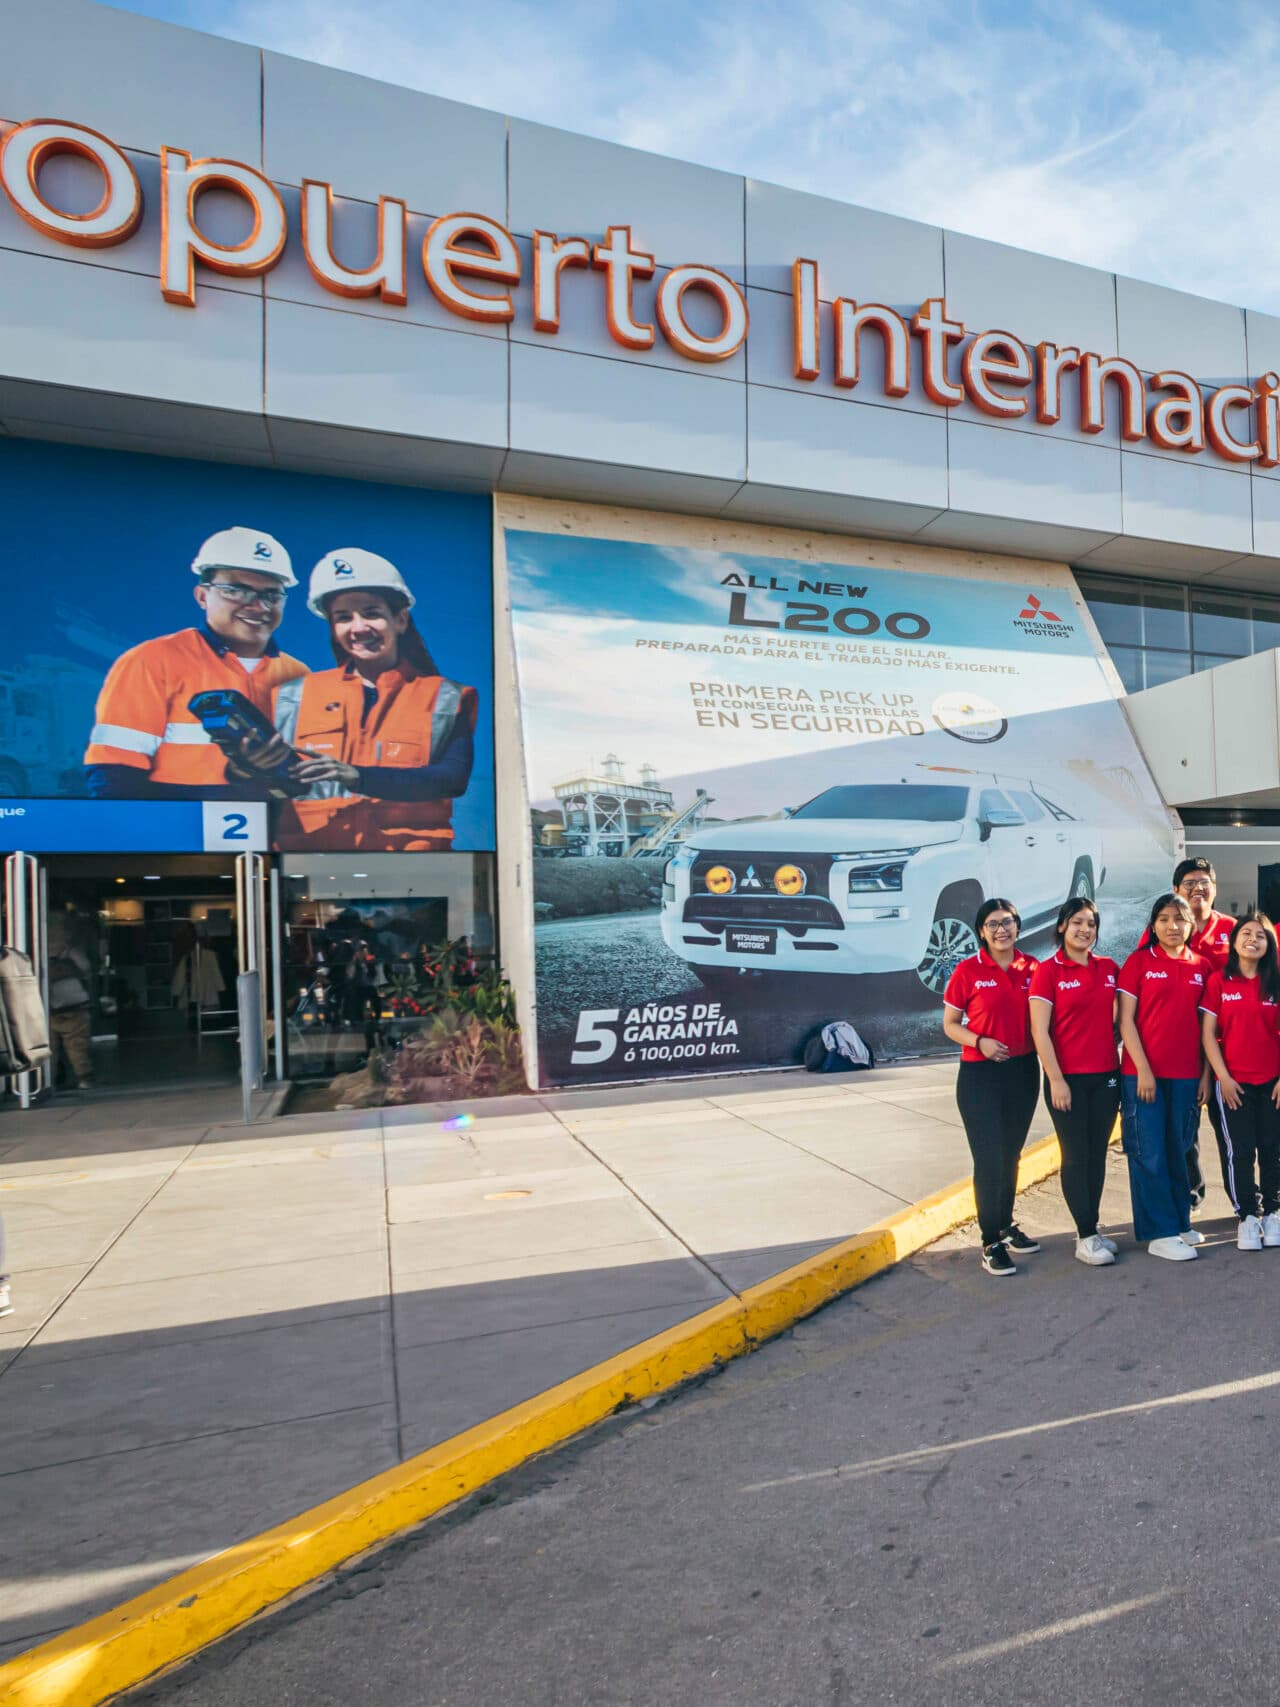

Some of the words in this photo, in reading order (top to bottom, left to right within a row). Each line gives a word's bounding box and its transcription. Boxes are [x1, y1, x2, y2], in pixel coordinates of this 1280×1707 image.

[0, 117, 749, 362] opuerto
[720, 573, 789, 591] ALL
[797, 580, 869, 598] NEW
[728, 591, 931, 639] L200
[1013, 620, 1075, 632] MITSUBISHI
[723, 633, 762, 646] MÁS
[766, 638, 829, 651] FUERTE
[834, 642, 868, 655] QUE
[872, 646, 891, 656] EL
[894, 647, 951, 660] SILLAR.
[1024, 628, 1070, 639] MOTORS
[635, 639, 748, 656] PREPARADA
[752, 648, 800, 660] PARA
[804, 652, 824, 661] EL
[828, 653, 903, 667] TRABAJO
[945, 661, 1021, 675] EXIGENTE.
[690, 682, 814, 702] PRIMERA
[820, 690, 877, 706] PICK
[882, 693, 914, 708] UP
[693, 698, 716, 708] EN
[721, 699, 816, 713] CONSEGUIR
[834, 705, 920, 719] ESTRELLAS
[695, 710, 740, 729] EN
[750, 713, 925, 736] SEGURIDAD
[222, 813, 249, 840] 2
[737, 941, 765, 949] MOTORS
[624, 1002, 688, 1025] AÑOS
[692, 1003, 721, 1021] DE
[570, 1008, 620, 1065] 5
[623, 1016, 739, 1043] GARANTÍA
[624, 1047, 636, 1062] ó
[640, 1043, 706, 1062] 100,000
[710, 1042, 741, 1056] km.
